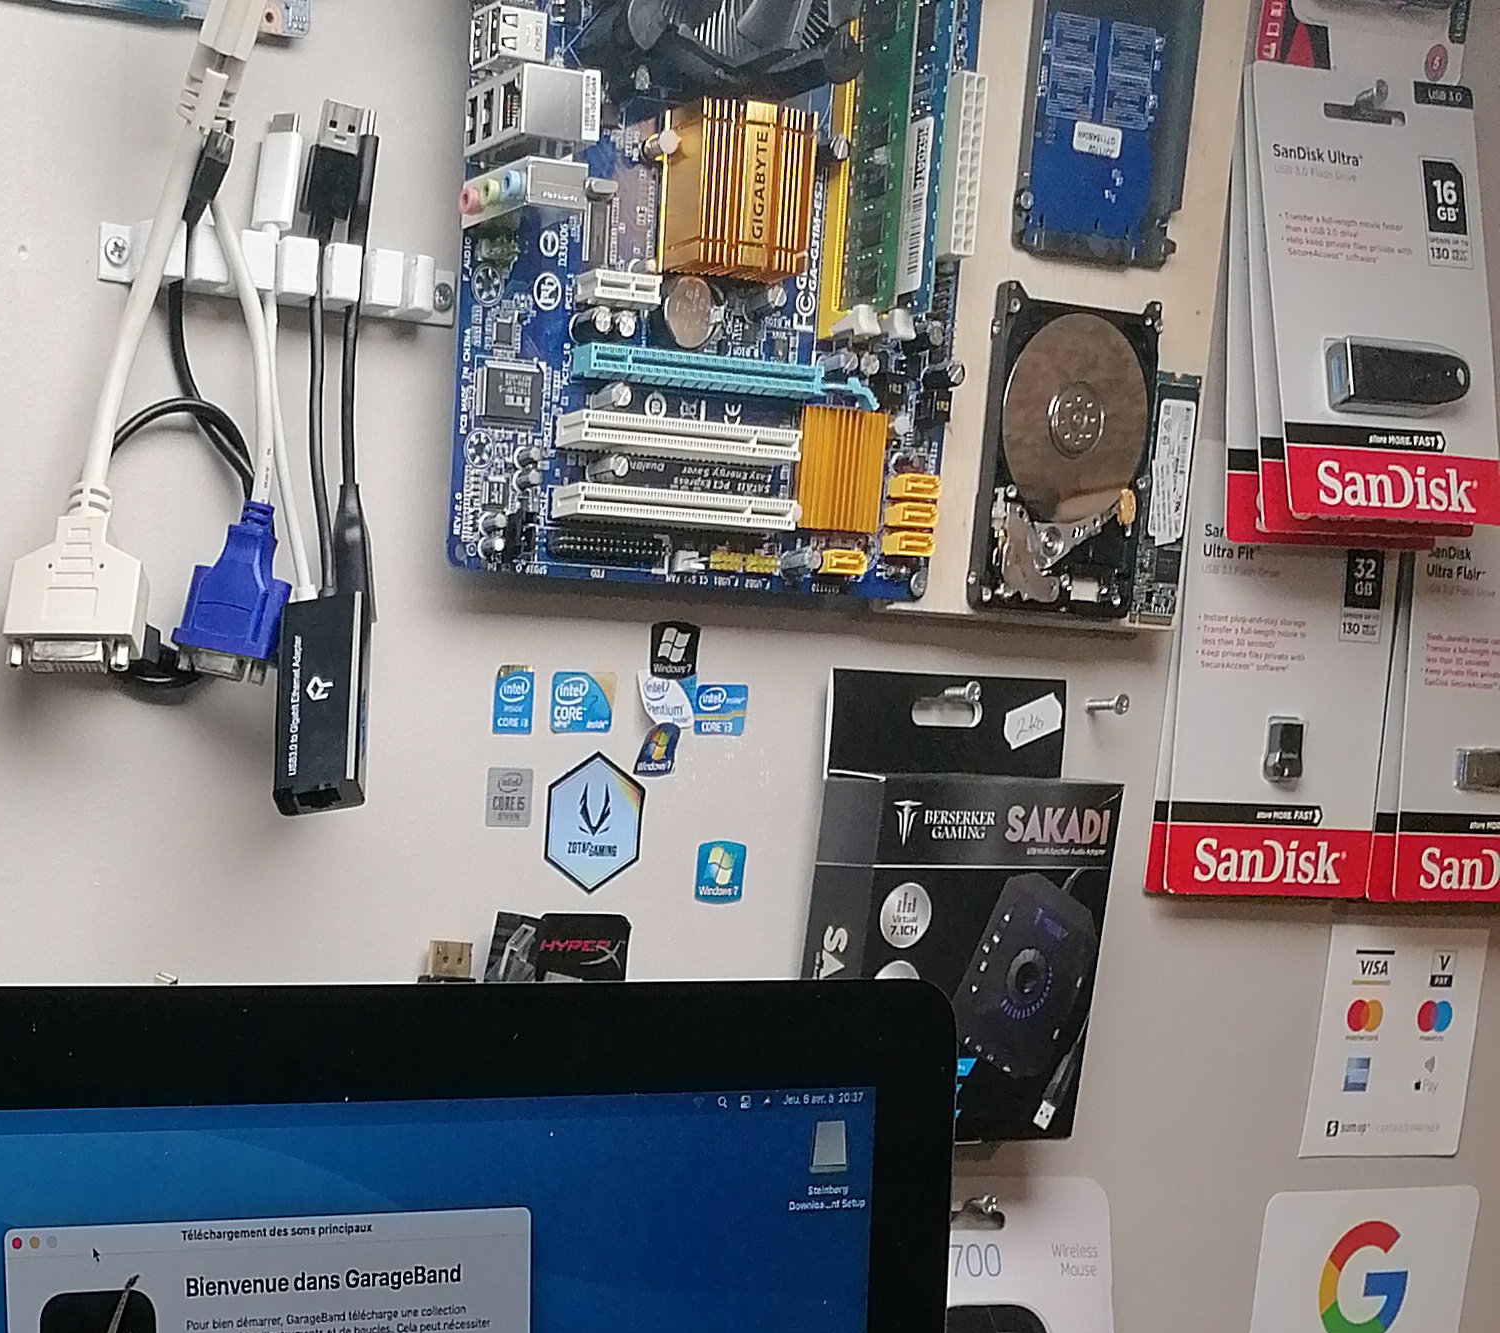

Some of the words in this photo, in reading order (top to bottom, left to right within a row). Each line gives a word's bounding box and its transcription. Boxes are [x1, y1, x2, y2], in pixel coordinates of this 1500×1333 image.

[1273, 143, 1325, 163] SanDisk
[1327, 149, 1360, 166] Ultra
[752, 131, 769, 240] GIGABYTE
[1432, 180, 1457, 205] 16
[1437, 207, 1458, 222] GB
[1430, 247, 1450, 260] 130
[463, 328, 472, 362] CHINA
[461, 367, 469, 380] IN
[461, 384, 470, 411] MADE
[1413, 435, 1437, 448] FAST
[1317, 459, 1477, 514] SanDisk
[1203, 544, 1234, 560] Ultra
[1237, 546, 1255, 560] Fit
[1354, 559, 1377, 580] 32
[1426, 564, 1453, 579] Ultra
[1456, 566, 1481, 580] Flair
[1354, 581, 1374, 596] GB
[1343, 622, 1360, 634] 130
[653, 663, 686, 674] Windows
[686, 663, 693, 673] 7
[554, 706, 584, 720] CORE
[648, 703, 683, 717] Pentium
[497, 717, 519, 728] CORE
[701, 722, 721, 732] CORE
[288, 744, 299, 776] USB3.0
[637, 762, 666, 772] Windows
[492, 796, 515, 810] CORE
[924, 809, 996, 826] BERSERKER
[1005, 804, 1111, 845] SAKADI
[931, 826, 987, 840] GAMING
[588, 844, 618, 857] GAMING
[1193, 837, 1341, 885] SanDisk
[698, 886, 732, 896] Windows
[733, 886, 740, 896] 7
[1360, 960, 1389, 976] VISA
[1439, 954, 1451, 972] V
[808, 1185, 849, 1196] Steinberg
[842, 1198, 866, 1209] Setup
[180, 1228, 268, 1242] Téléchargement
[268, 1226, 289, 1238] des
[290, 1226, 316, 1238] sons
[318, 1222, 372, 1238] principaux
[1050, 1242, 1099, 1259] Wireless
[1060, 1262, 1098, 1278] Mouse
[186, 1276, 290, 1298] Bienvenue
[293, 1271, 340, 1292] dans
[344, 1263, 462, 1291] GarageBand
